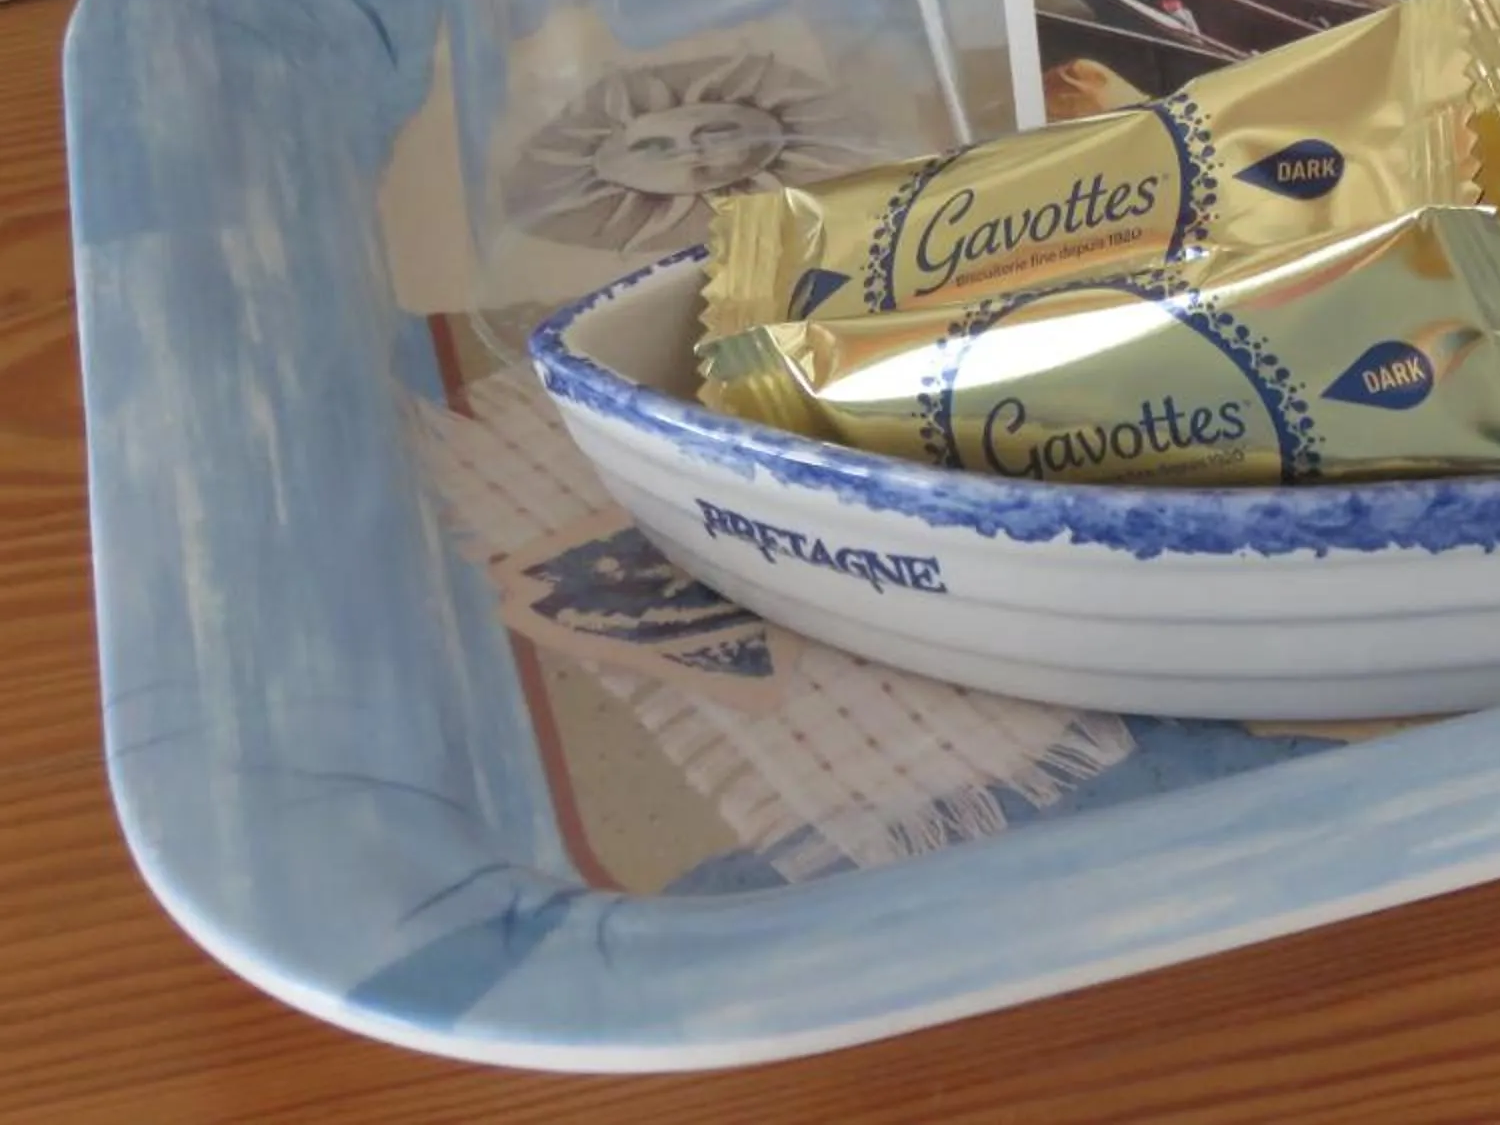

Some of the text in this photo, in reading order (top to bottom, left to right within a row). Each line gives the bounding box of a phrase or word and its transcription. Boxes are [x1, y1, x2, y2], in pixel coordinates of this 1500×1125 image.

[1278, 157, 1336, 183] DARK
[914, 172, 1159, 297] Gavottes
[1362, 356, 1425, 394] DARK
[981, 394, 1247, 481] Gavottes
[695, 497, 947, 594] BRETAGNE
